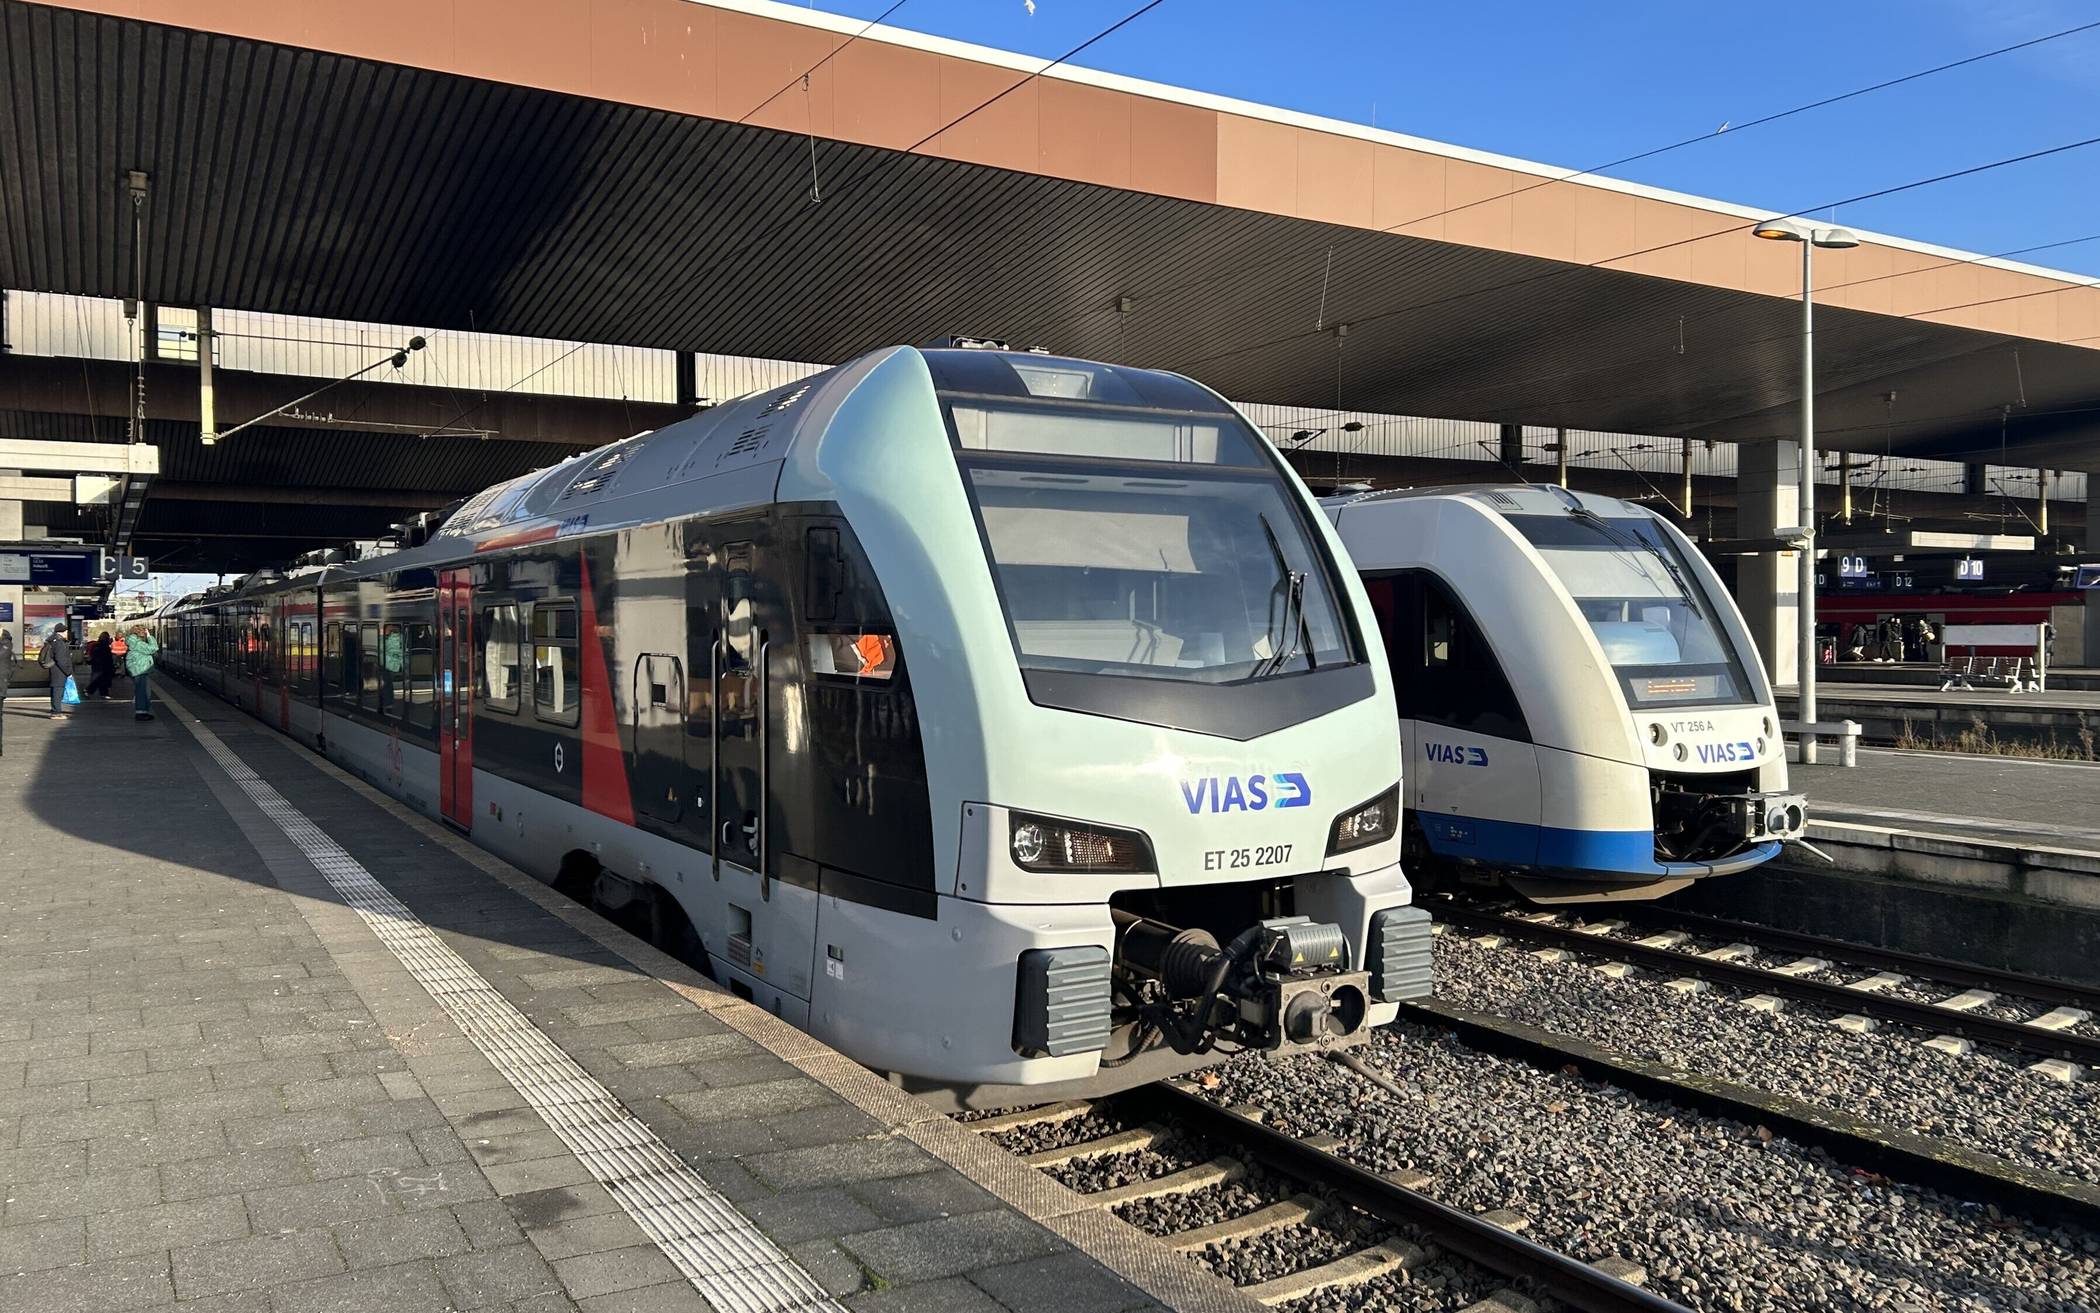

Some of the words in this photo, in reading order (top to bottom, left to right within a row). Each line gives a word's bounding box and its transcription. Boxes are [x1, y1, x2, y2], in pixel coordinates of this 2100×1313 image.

[104, 556, 116, 574] C
[132, 557, 145, 575] 5
[1842, 556, 1850, 573] 9
[1855, 557, 1864, 573] D
[1960, 560, 1969, 576] D
[1970, 560, 1983, 576] 10
[1818, 574, 1825, 585] D
[1896, 576, 1902, 587] D
[1904, 576, 1913, 587] 12
[1671, 722, 1685, 733] VT
[1688, 721, 1705, 732] 256
[1706, 721, 1714, 731] A
[1425, 743, 1465, 764] VIAS
[1696, 743, 1736, 763] VIAS
[1180, 774, 1268, 814] VIAS
[1204, 850, 1226, 871] ET
[1230, 848, 1250, 869] 25
[1255, 844, 1293, 866] 2207
